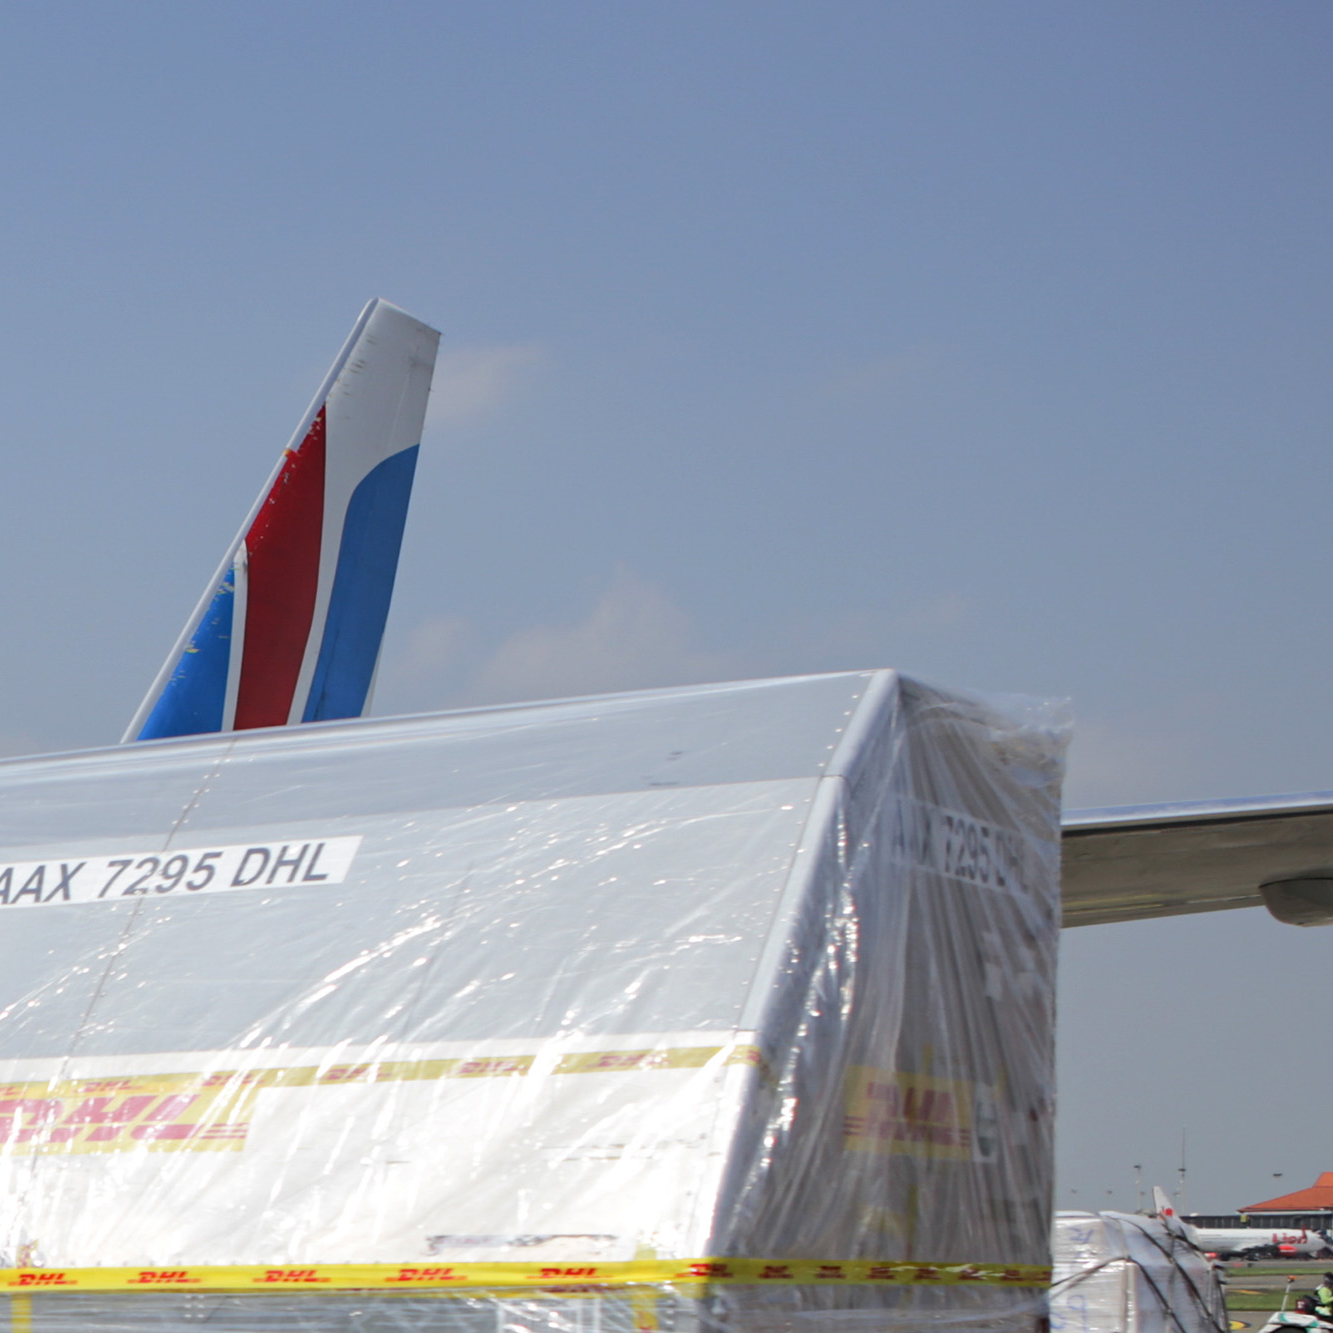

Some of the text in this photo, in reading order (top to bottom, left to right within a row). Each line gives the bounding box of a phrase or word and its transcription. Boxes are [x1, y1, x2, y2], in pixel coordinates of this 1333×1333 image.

[97, 851, 222, 899] 7295
[230, 842, 329, 888] DHL
[84, 1081, 132, 1093] DHL
[18, 1273, 67, 1286] DHL
[138, 1270, 190, 1283] DHL
[264, 1269, 319, 1282] DHL
[398, 1268, 455, 1281] DHL
[540, 1267, 598, 1279] DHL
